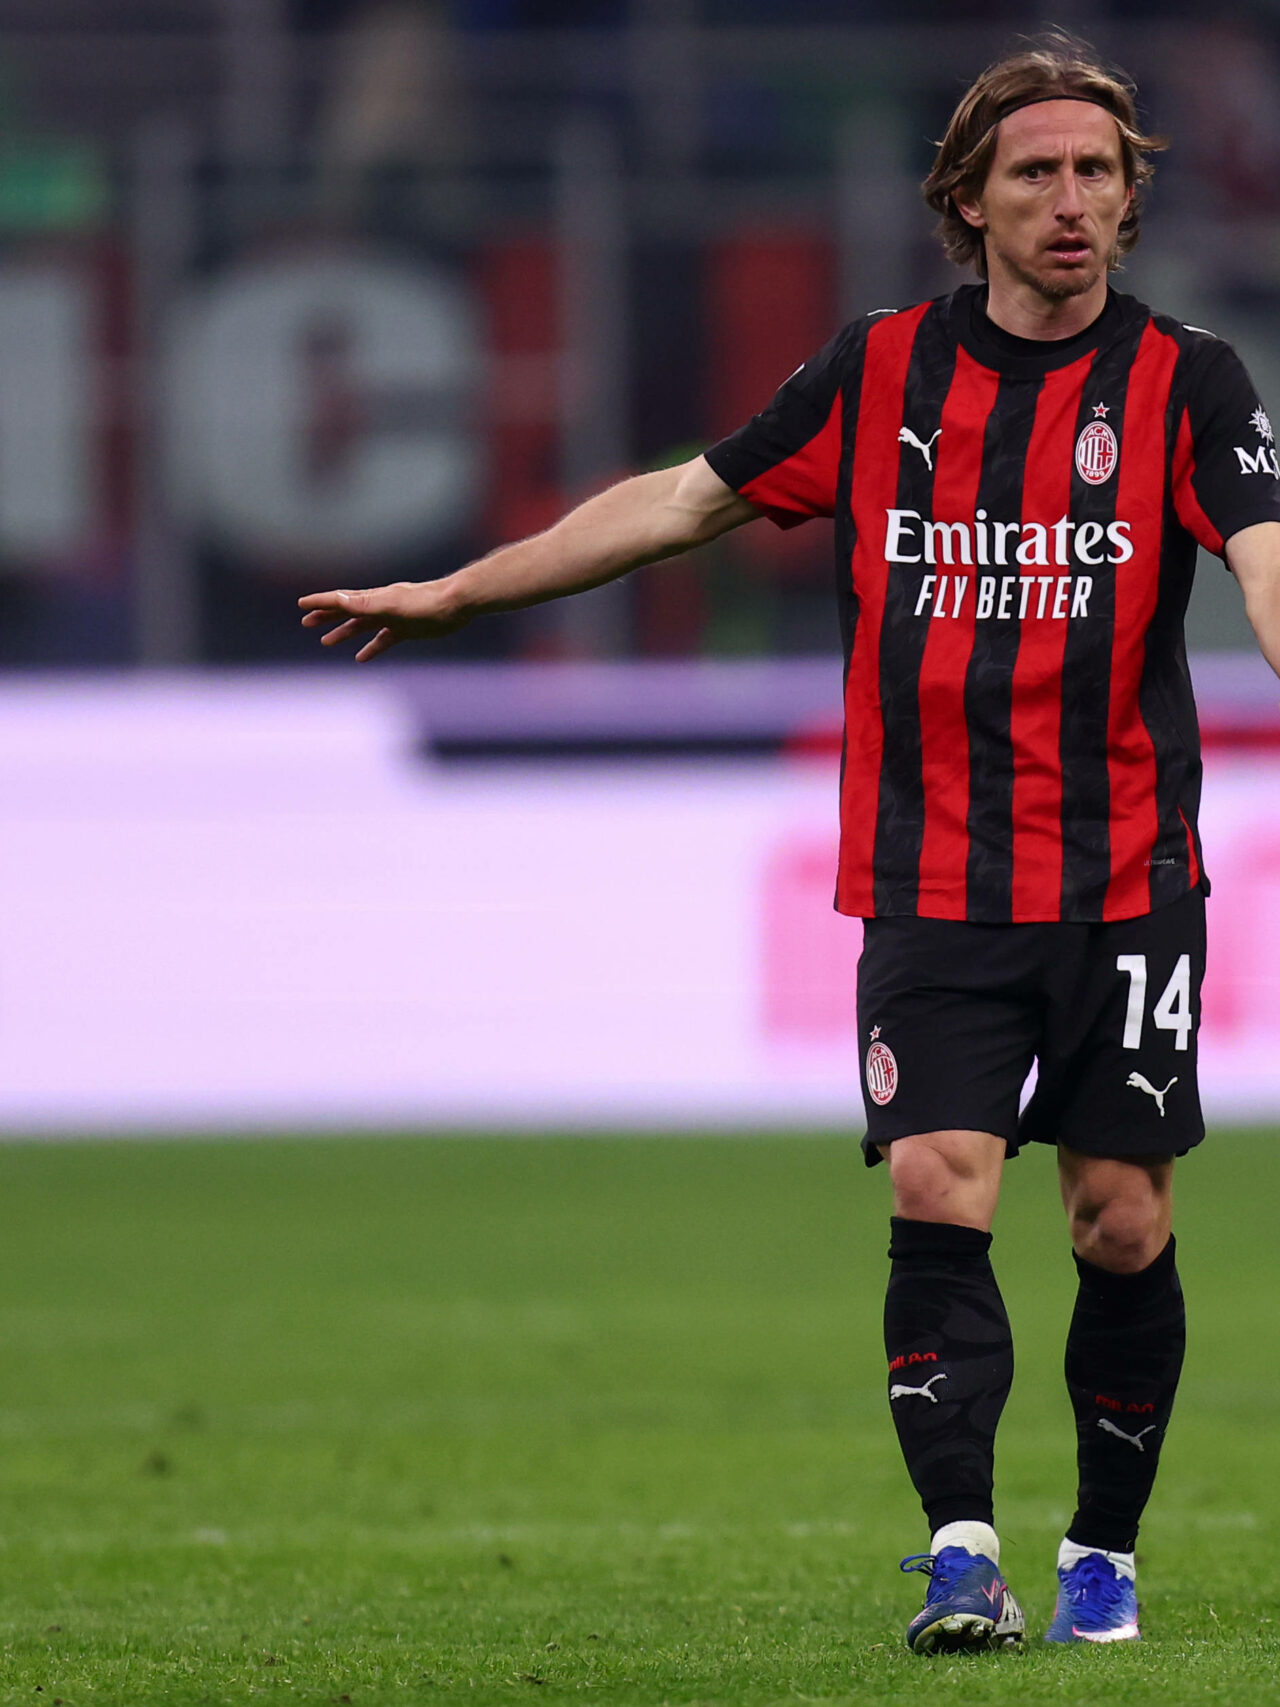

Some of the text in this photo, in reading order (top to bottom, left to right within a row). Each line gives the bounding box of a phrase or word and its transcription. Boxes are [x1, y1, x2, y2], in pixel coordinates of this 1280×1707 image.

[884, 508, 1135, 566] Emirates
[913, 575, 1094, 620] FLY BETTER
[1116, 953, 1192, 1051] 14
